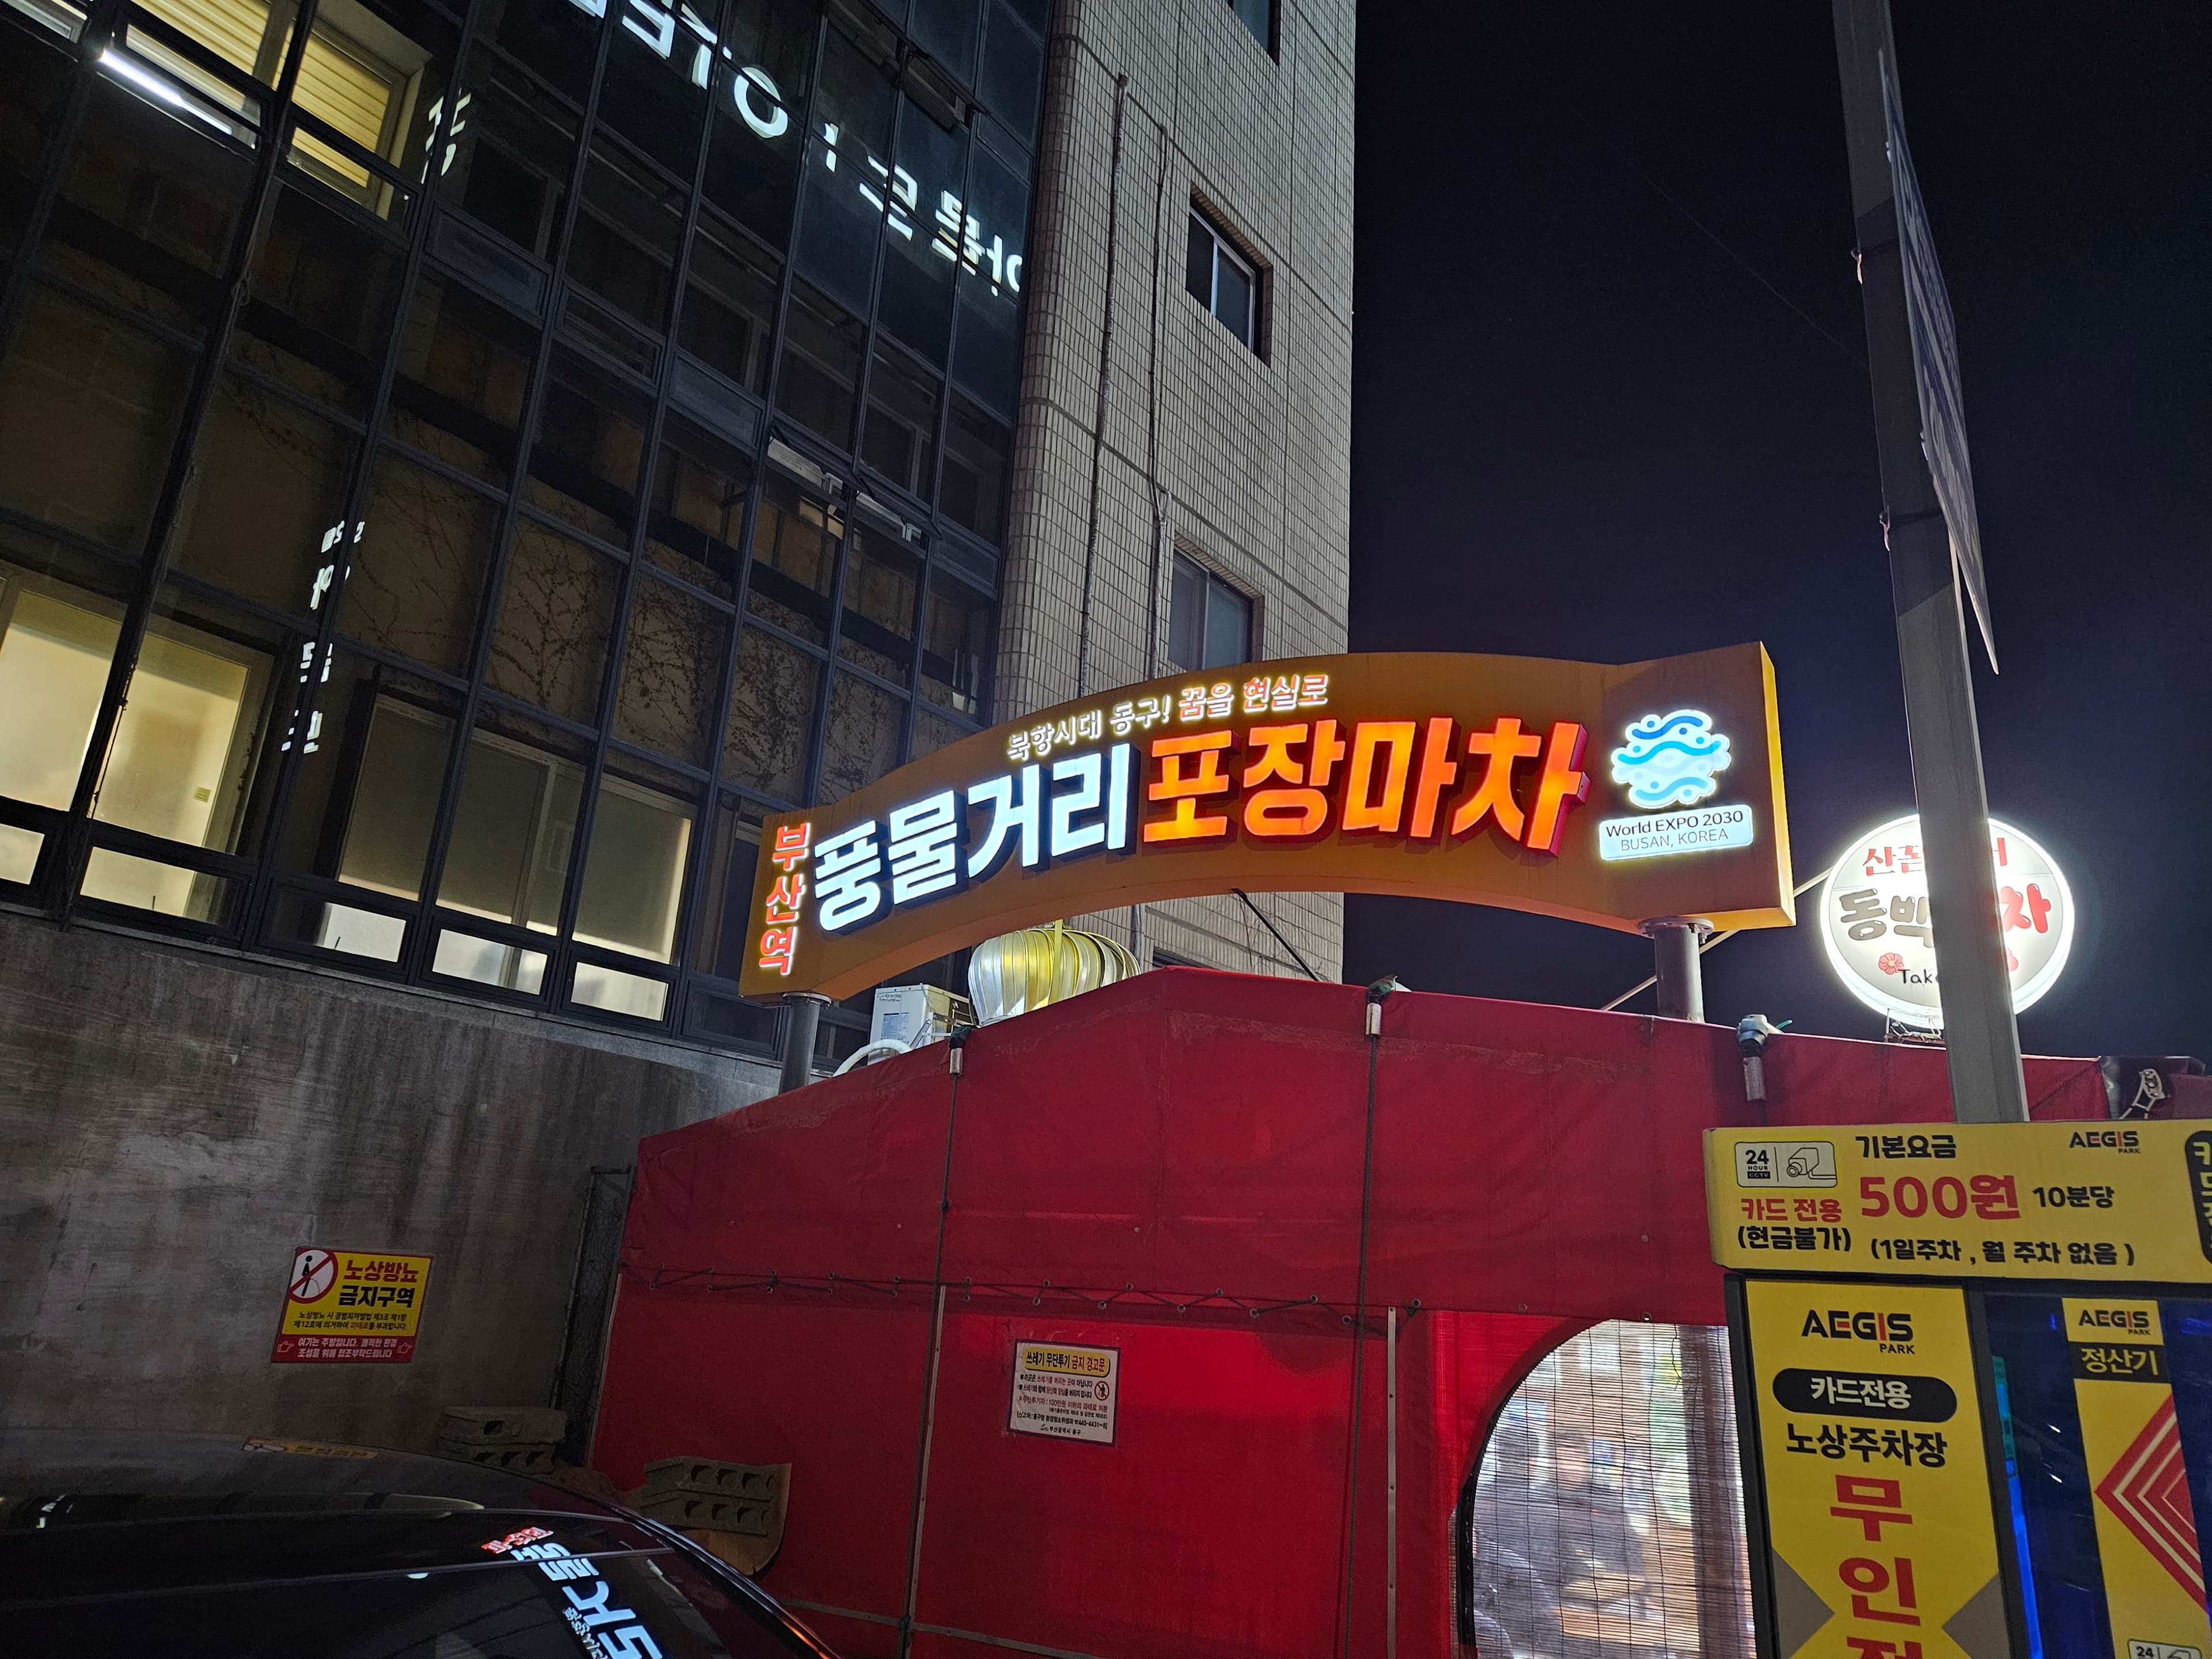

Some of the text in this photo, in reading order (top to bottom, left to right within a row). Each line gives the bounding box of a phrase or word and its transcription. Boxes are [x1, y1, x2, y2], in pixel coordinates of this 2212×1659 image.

[1007, 674, 1328, 762] 북항시대 동구! 꿈을 현실로
[812, 716, 1585, 933] 풍물거리 포장마차
[1606, 810, 1744, 838] World EXPO 2030
[1620, 828, 1729, 851] BUSAN, KOREA
[759, 820, 812, 976] 부산역
[1897, 968, 1940, 985] Tak
[1855, 1134, 1957, 1160] 기본요금
[2069, 1130, 2139, 1149] AEGIS
[1745, 1149, 1770, 1165] 24
[1859, 1174, 2115, 1221] 500원 10분당
[1741, 1198, 1842, 1223] 카드 전용
[1737, 1225, 1852, 1252] (현금불가)
[1982, 1241, 2005, 1264] 월
[2013, 1240, 2061, 1265] 주차
[344, 1259, 419, 1283] 노상방뇨
[338, 1285, 415, 1308] 금지구역
[323, 1321, 349, 1330] 의거하여
[1801, 1309, 1914, 1342] AEGIS
[2078, 1308, 2150, 1330] AEGIS
[298, 1337, 320, 1347] 여기는
[384, 1339, 397, 1348] 환경
[2127, 1328, 2152, 1336] PARK
[297, 1349, 320, 1358] 조성을
[322, 1349, 336, 1358] 위해
[1879, 1343, 1915, 1355] PARK
[1026, 1351, 1105, 1372] 쓰레기 무단투기 금지 경고문
[2080, 1347, 2159, 1376] 정산기
[1810, 1375, 1912, 1410] 카드전용
[1785, 1422, 1948, 1468] 노상주차장
[2136, 1646, 2155, 1657] 24
